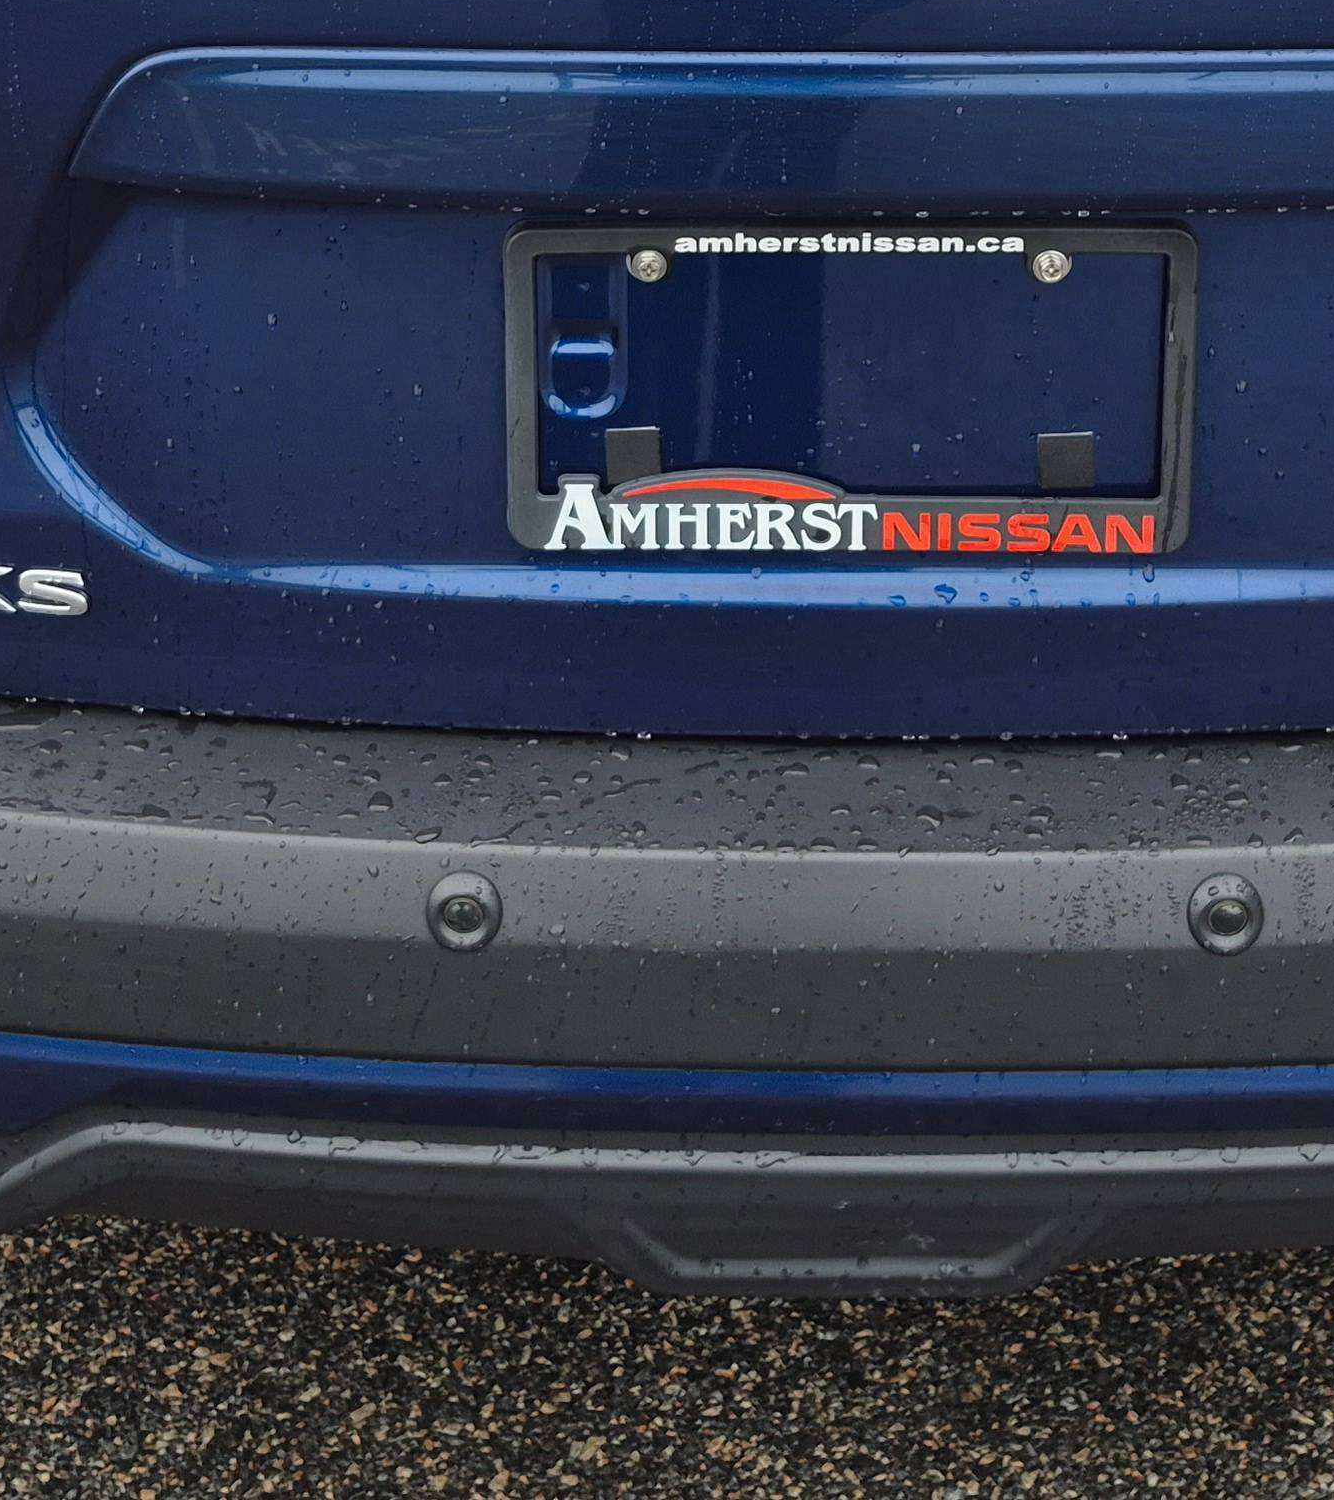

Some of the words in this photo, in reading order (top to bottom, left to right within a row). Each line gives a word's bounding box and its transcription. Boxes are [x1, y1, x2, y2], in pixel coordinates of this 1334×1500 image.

[673, 231, 1025, 254] amherstnissan.ca
[543, 483, 878, 551] AMHERST
[881, 511, 1155, 554] NISSAN
